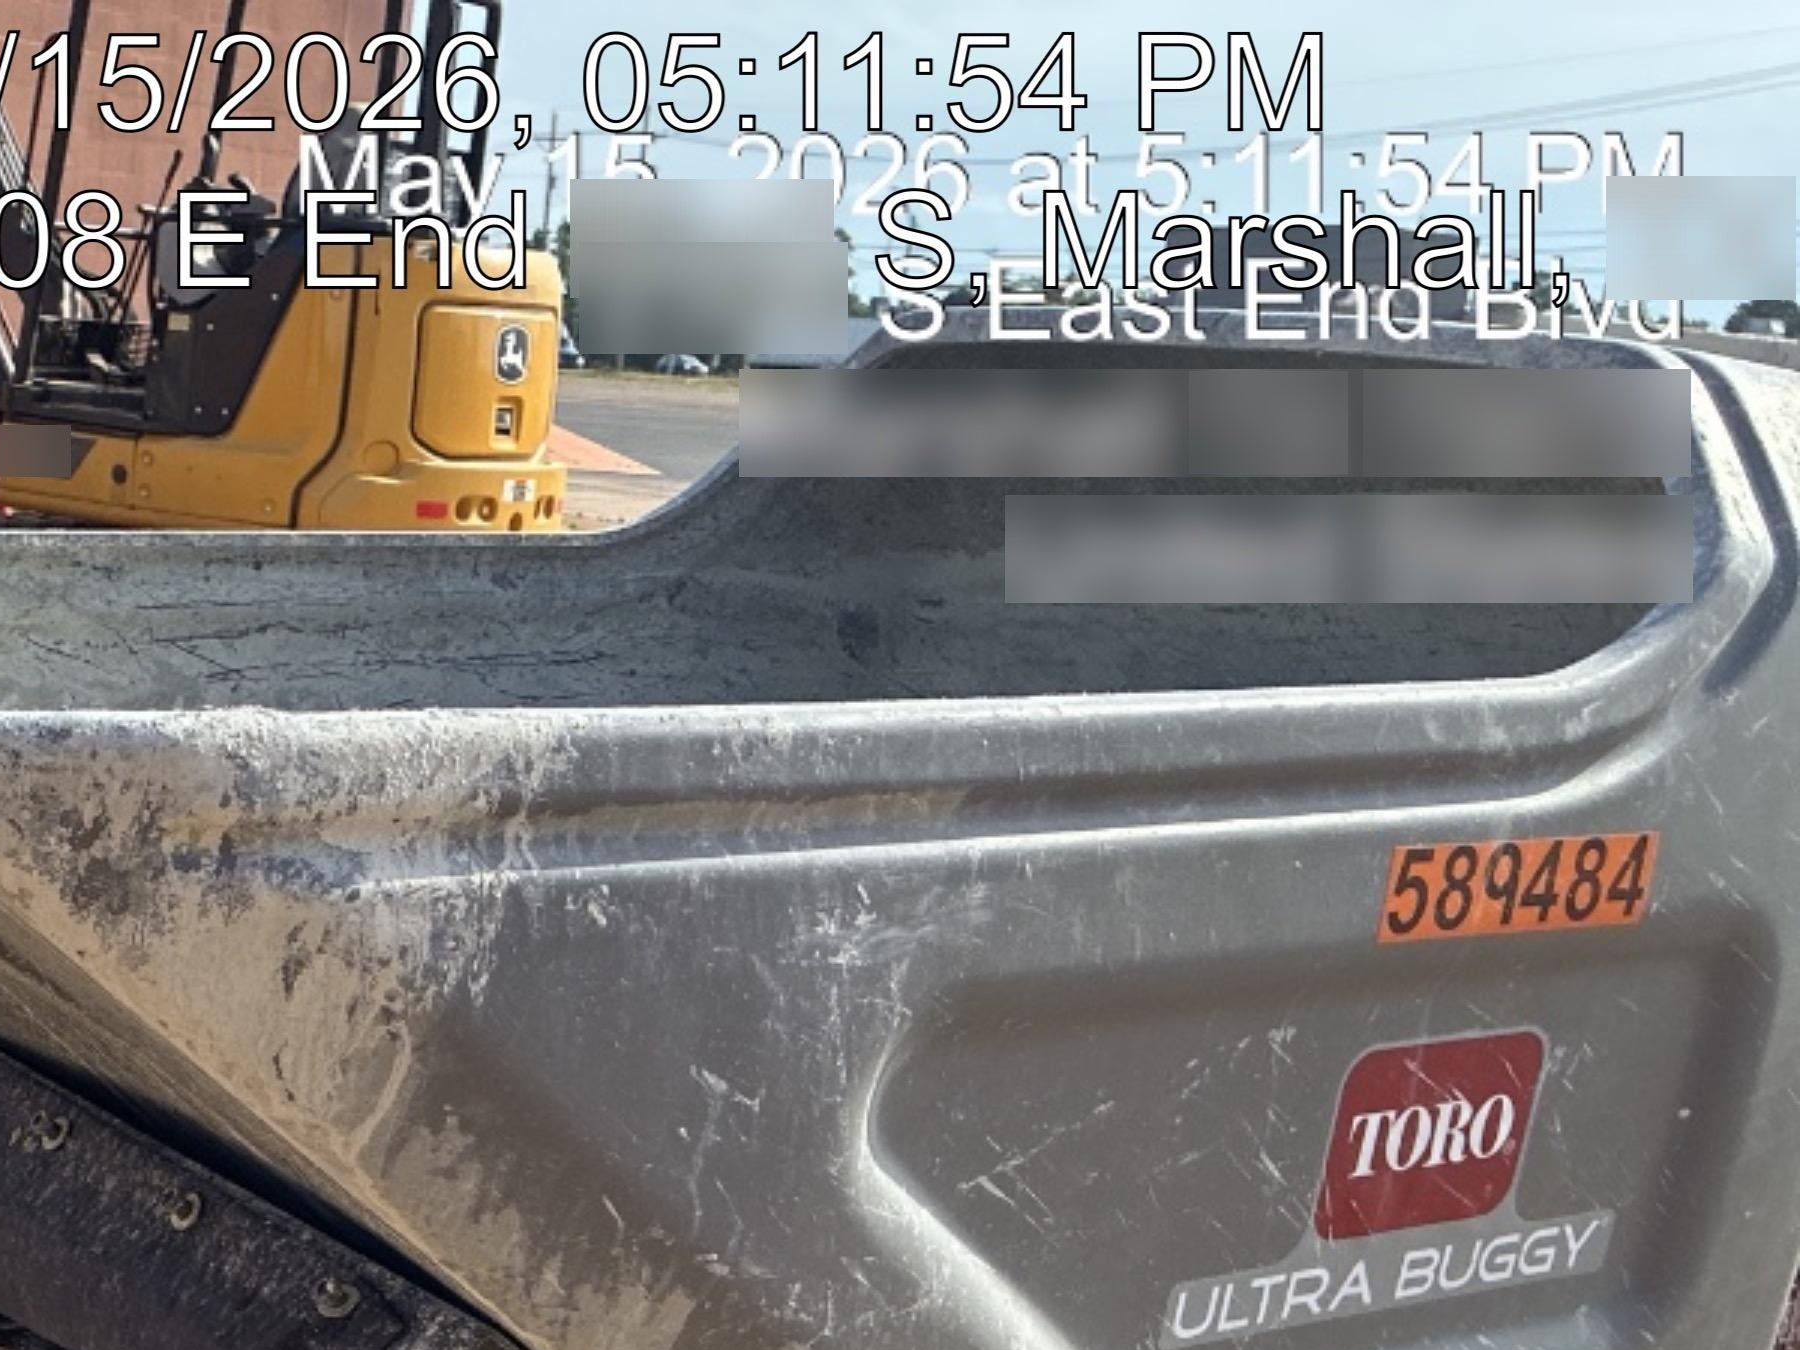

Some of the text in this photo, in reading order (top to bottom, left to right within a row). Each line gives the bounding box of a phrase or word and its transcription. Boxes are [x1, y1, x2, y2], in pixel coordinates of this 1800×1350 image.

[1387, 834, 1650, 935] 589484
[1347, 1093, 1516, 1179] TORO
[1171, 1219, 1601, 1341] ULTRA BUGGY
